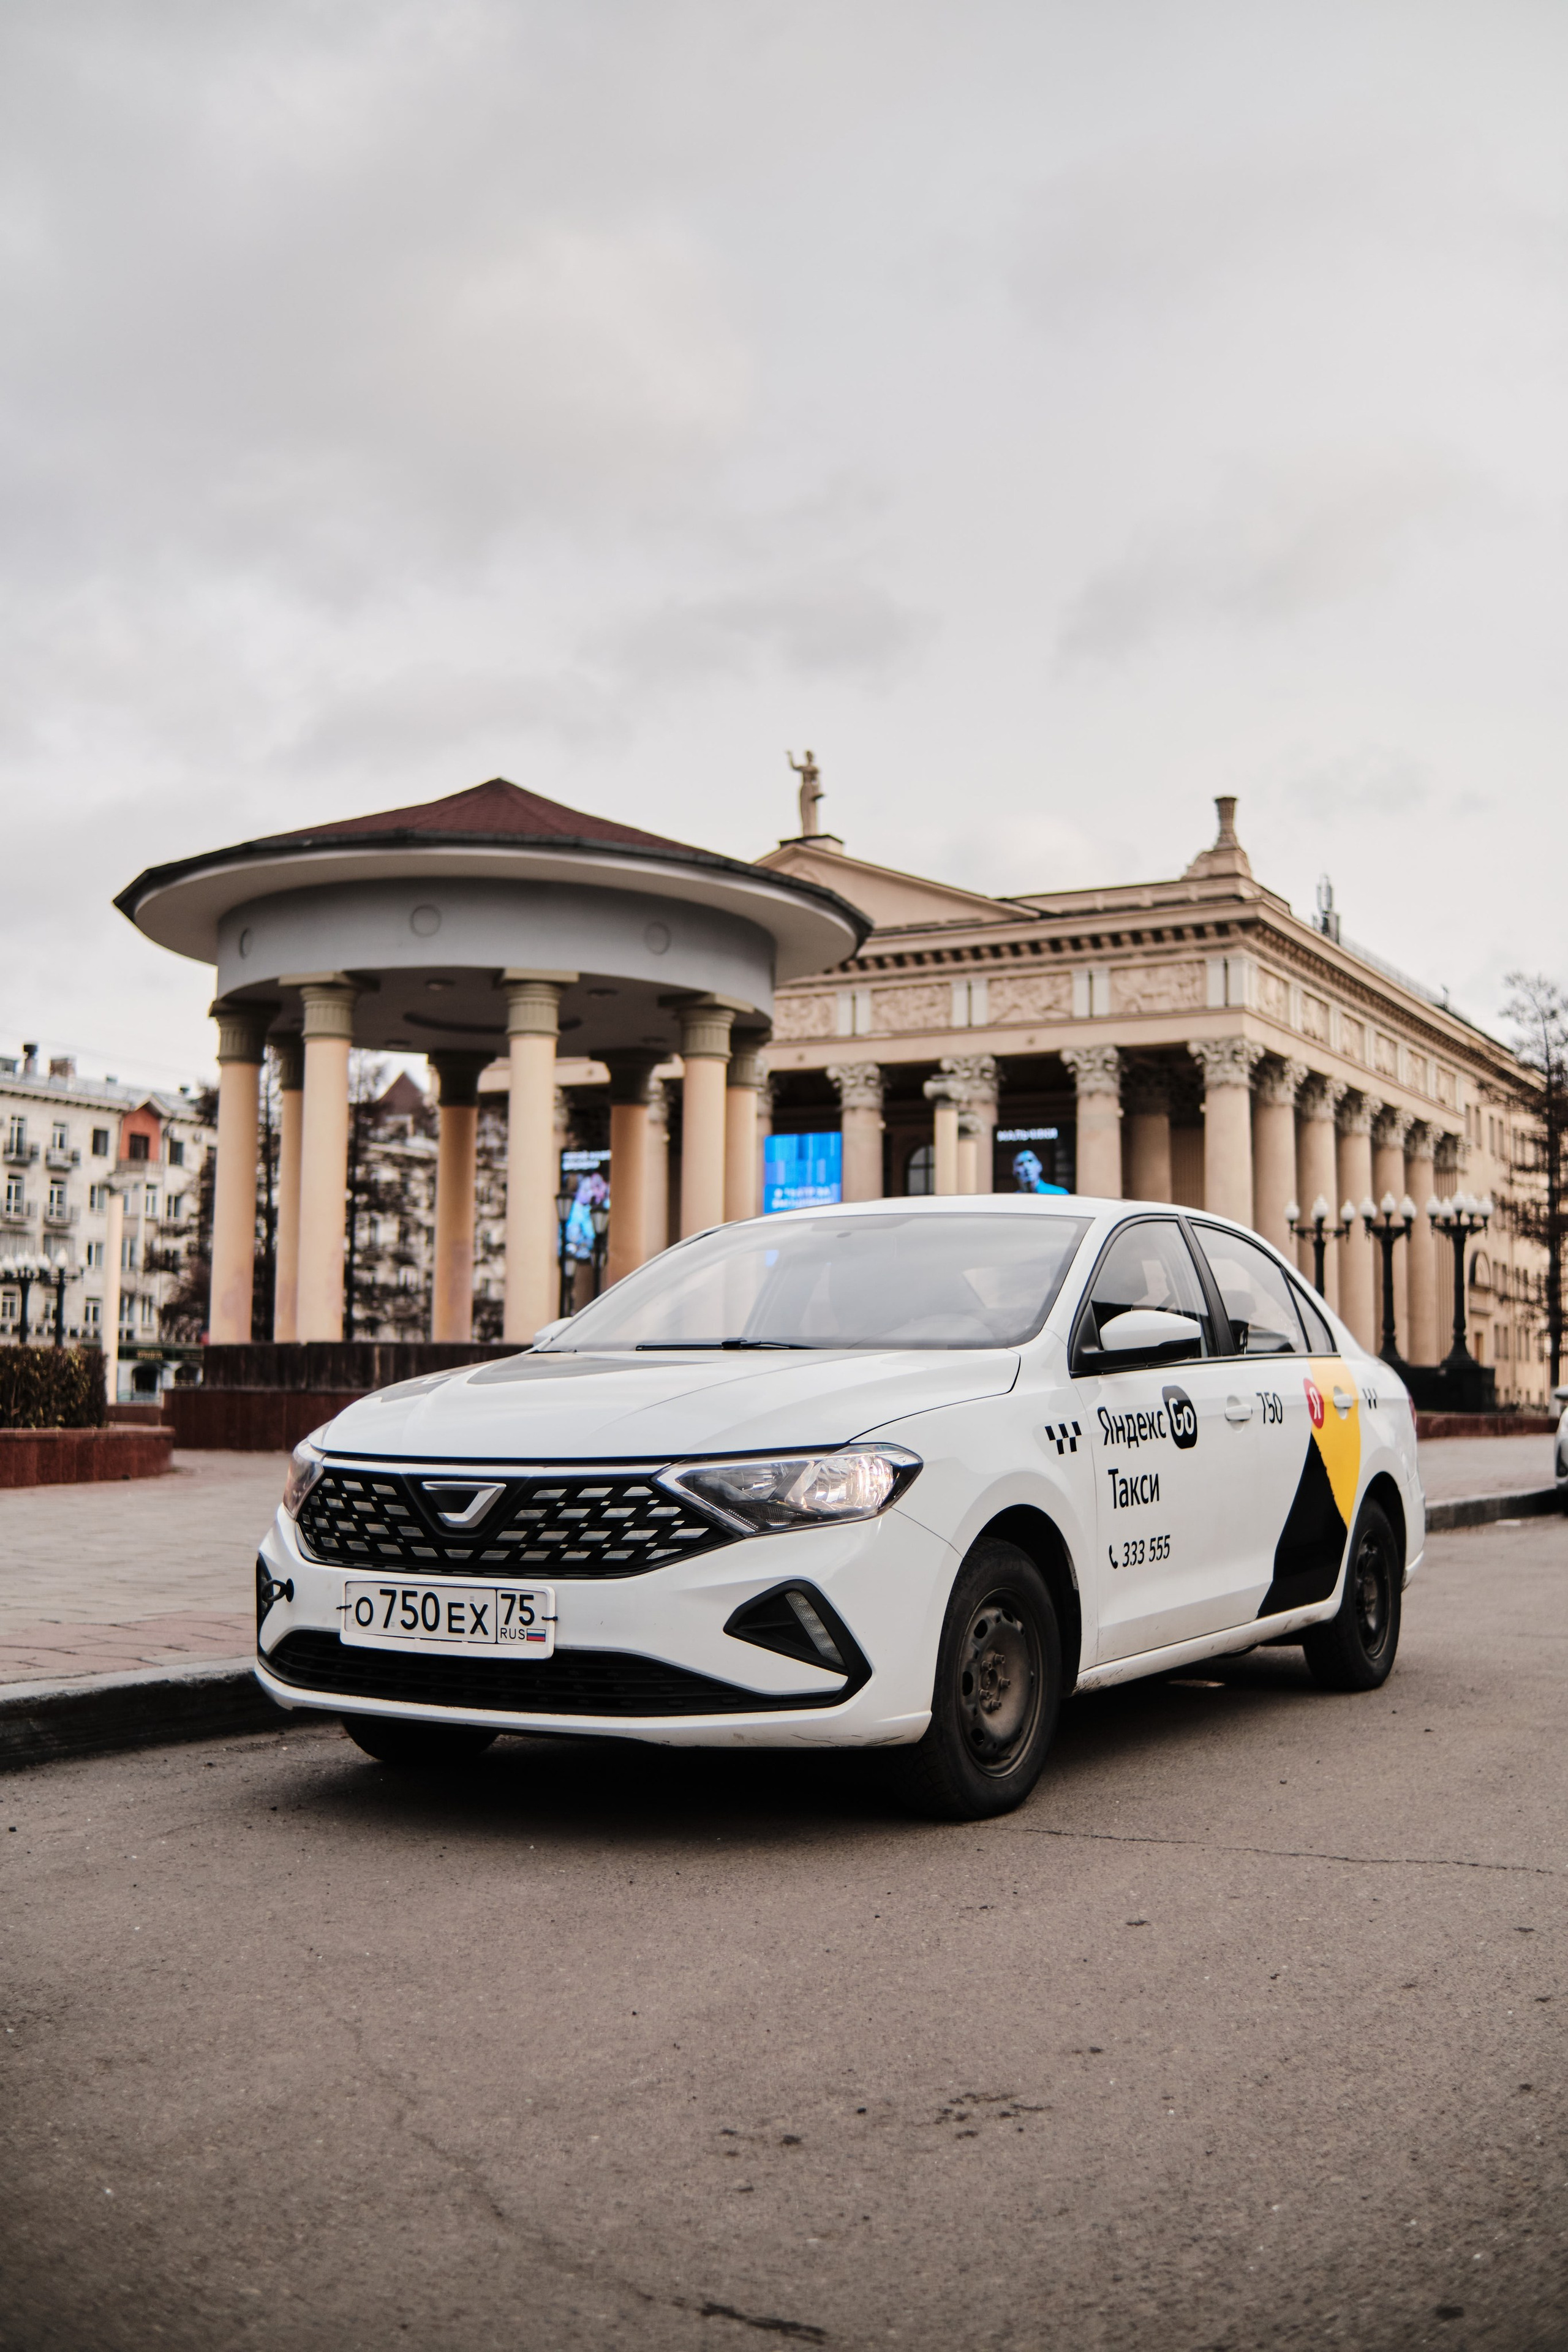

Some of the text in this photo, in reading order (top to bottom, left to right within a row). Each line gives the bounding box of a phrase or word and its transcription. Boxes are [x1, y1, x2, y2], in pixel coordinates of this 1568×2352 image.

[1097, 1397, 1194, 1449] Яндекс Go
[1256, 1392, 1283, 1424] 750
[1107, 1468, 1159, 1509] Такси
[1122, 1534, 1170, 1567] 333 555
[500, 1594, 535, 1626] 75
[500, 1628, 526, 1640] RUS
